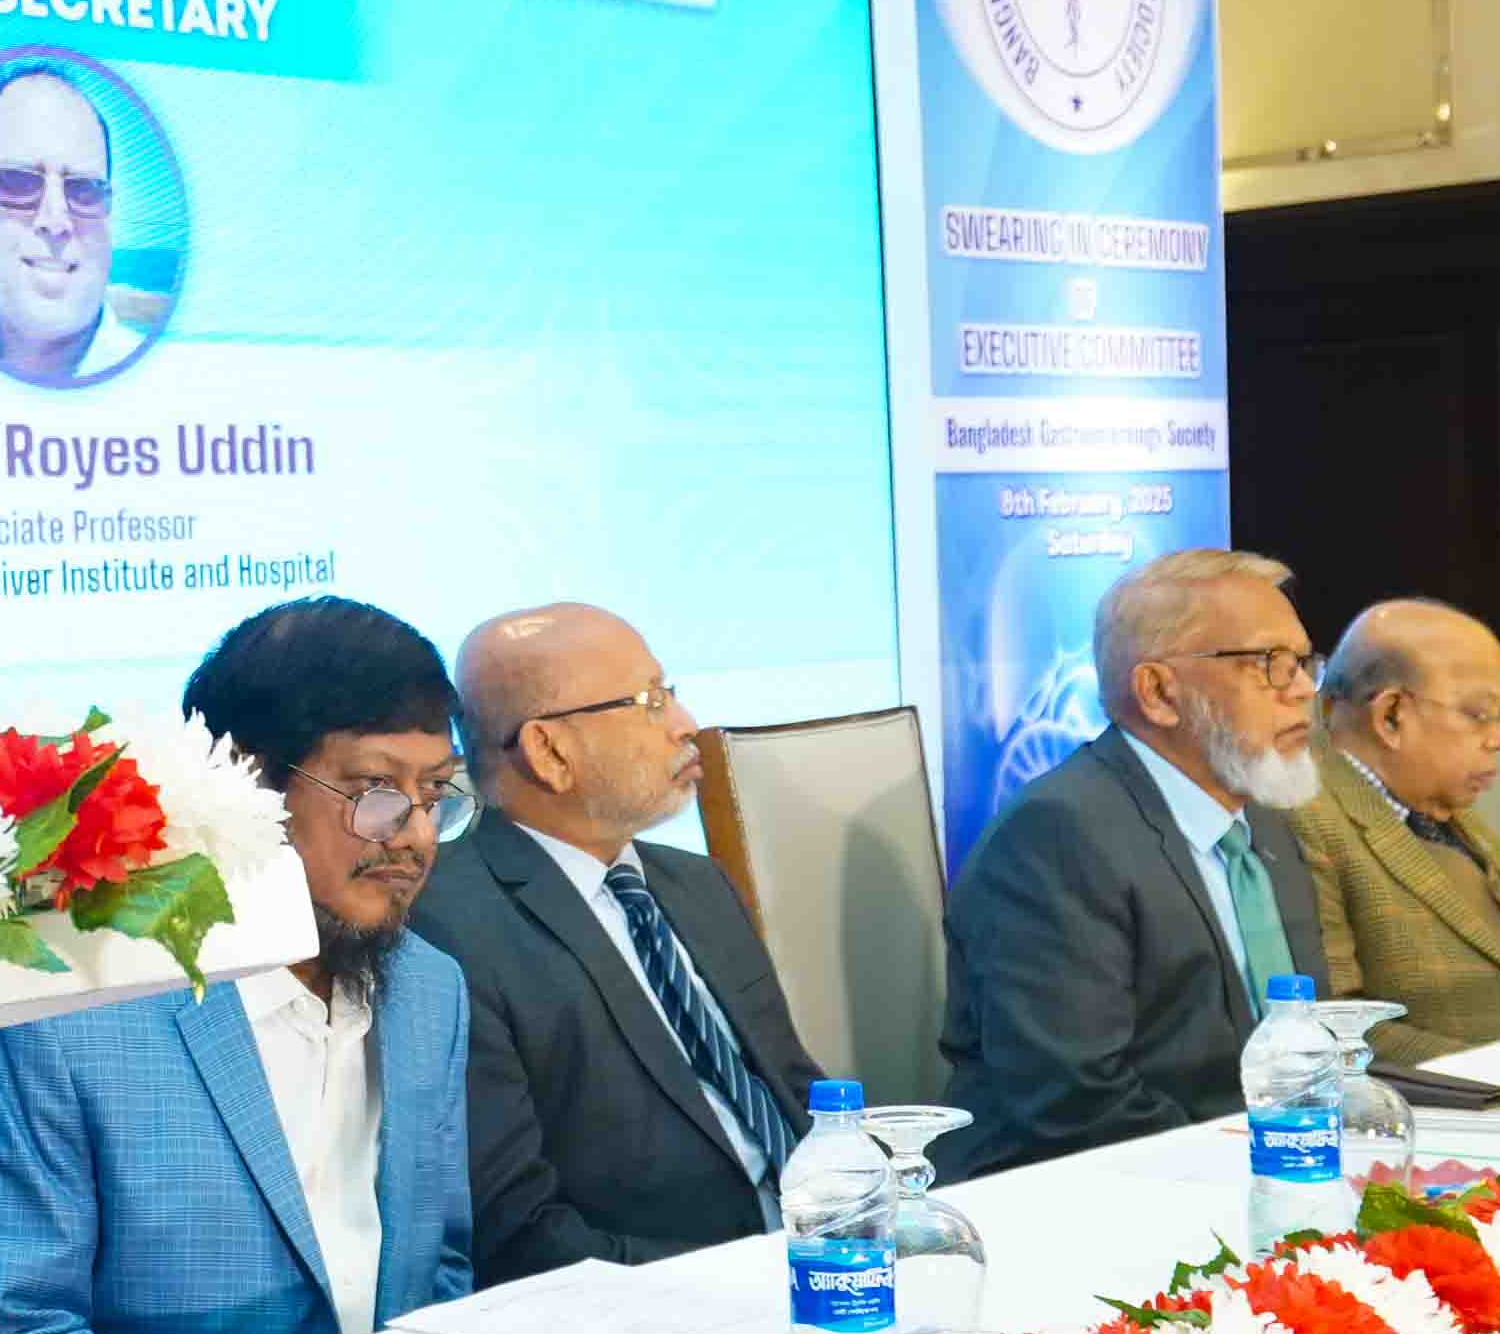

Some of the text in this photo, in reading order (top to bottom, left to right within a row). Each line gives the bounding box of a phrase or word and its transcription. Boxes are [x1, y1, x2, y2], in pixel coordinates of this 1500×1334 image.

[944, 211, 1063, 257] SWEARING
[963, 329, 1072, 368] EXECUTIVE
[946, 416, 1034, 455] Bangladesh
[1166, 420, 1217, 453] Society
[5, 423, 161, 490] Royes
[177, 423, 316, 476] Uddin
[72, 509, 197, 544] Professor
[61, 559, 173, 594] Institute
[184, 554, 229, 589] and
[238, 551, 336, 591] Hospital
